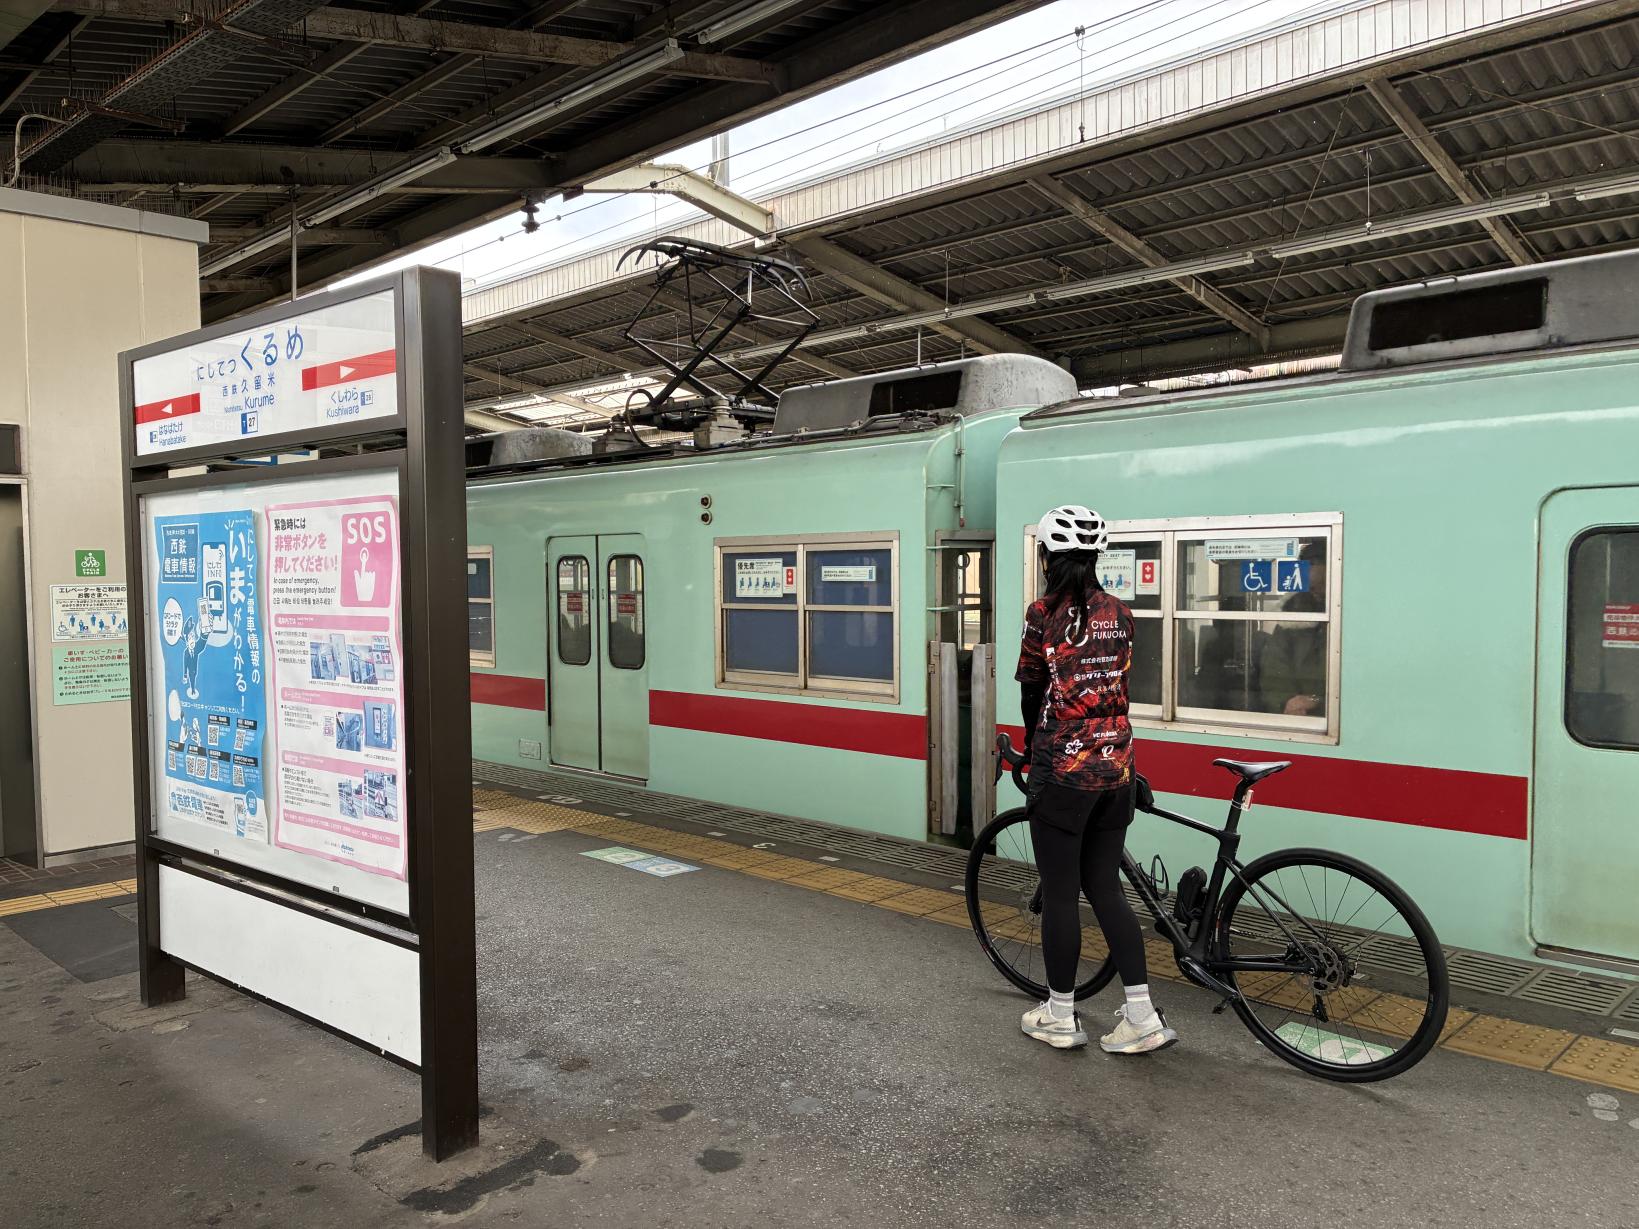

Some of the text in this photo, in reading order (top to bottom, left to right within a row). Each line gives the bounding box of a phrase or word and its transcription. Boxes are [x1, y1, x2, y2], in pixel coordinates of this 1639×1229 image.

[196, 325, 304, 382] にしてつくるめ
[222, 371, 276, 397] 西鉄久留米
[244, 393, 275, 410] Kurume
[330, 387, 359, 404] くしわら
[326, 405, 360, 418] Kushiwara
[158, 421, 184, 436] はなばたけ
[248, 417, 256, 427] 27
[273, 517, 306, 531] 緊急時には
[346, 515, 386, 545] SOS
[170, 538, 187, 555] 西鉄
[273, 532, 327, 552] 非常ボタンを
[164, 557, 196, 574] 電車情報
[246, 528, 261, 684] にしてつ電車情報の
[1091, 620, 1119, 630] CYCLE
[1092, 630, 1127, 640] FUKUOKA
[63, 654, 129, 663] ご使用についてのお願い
